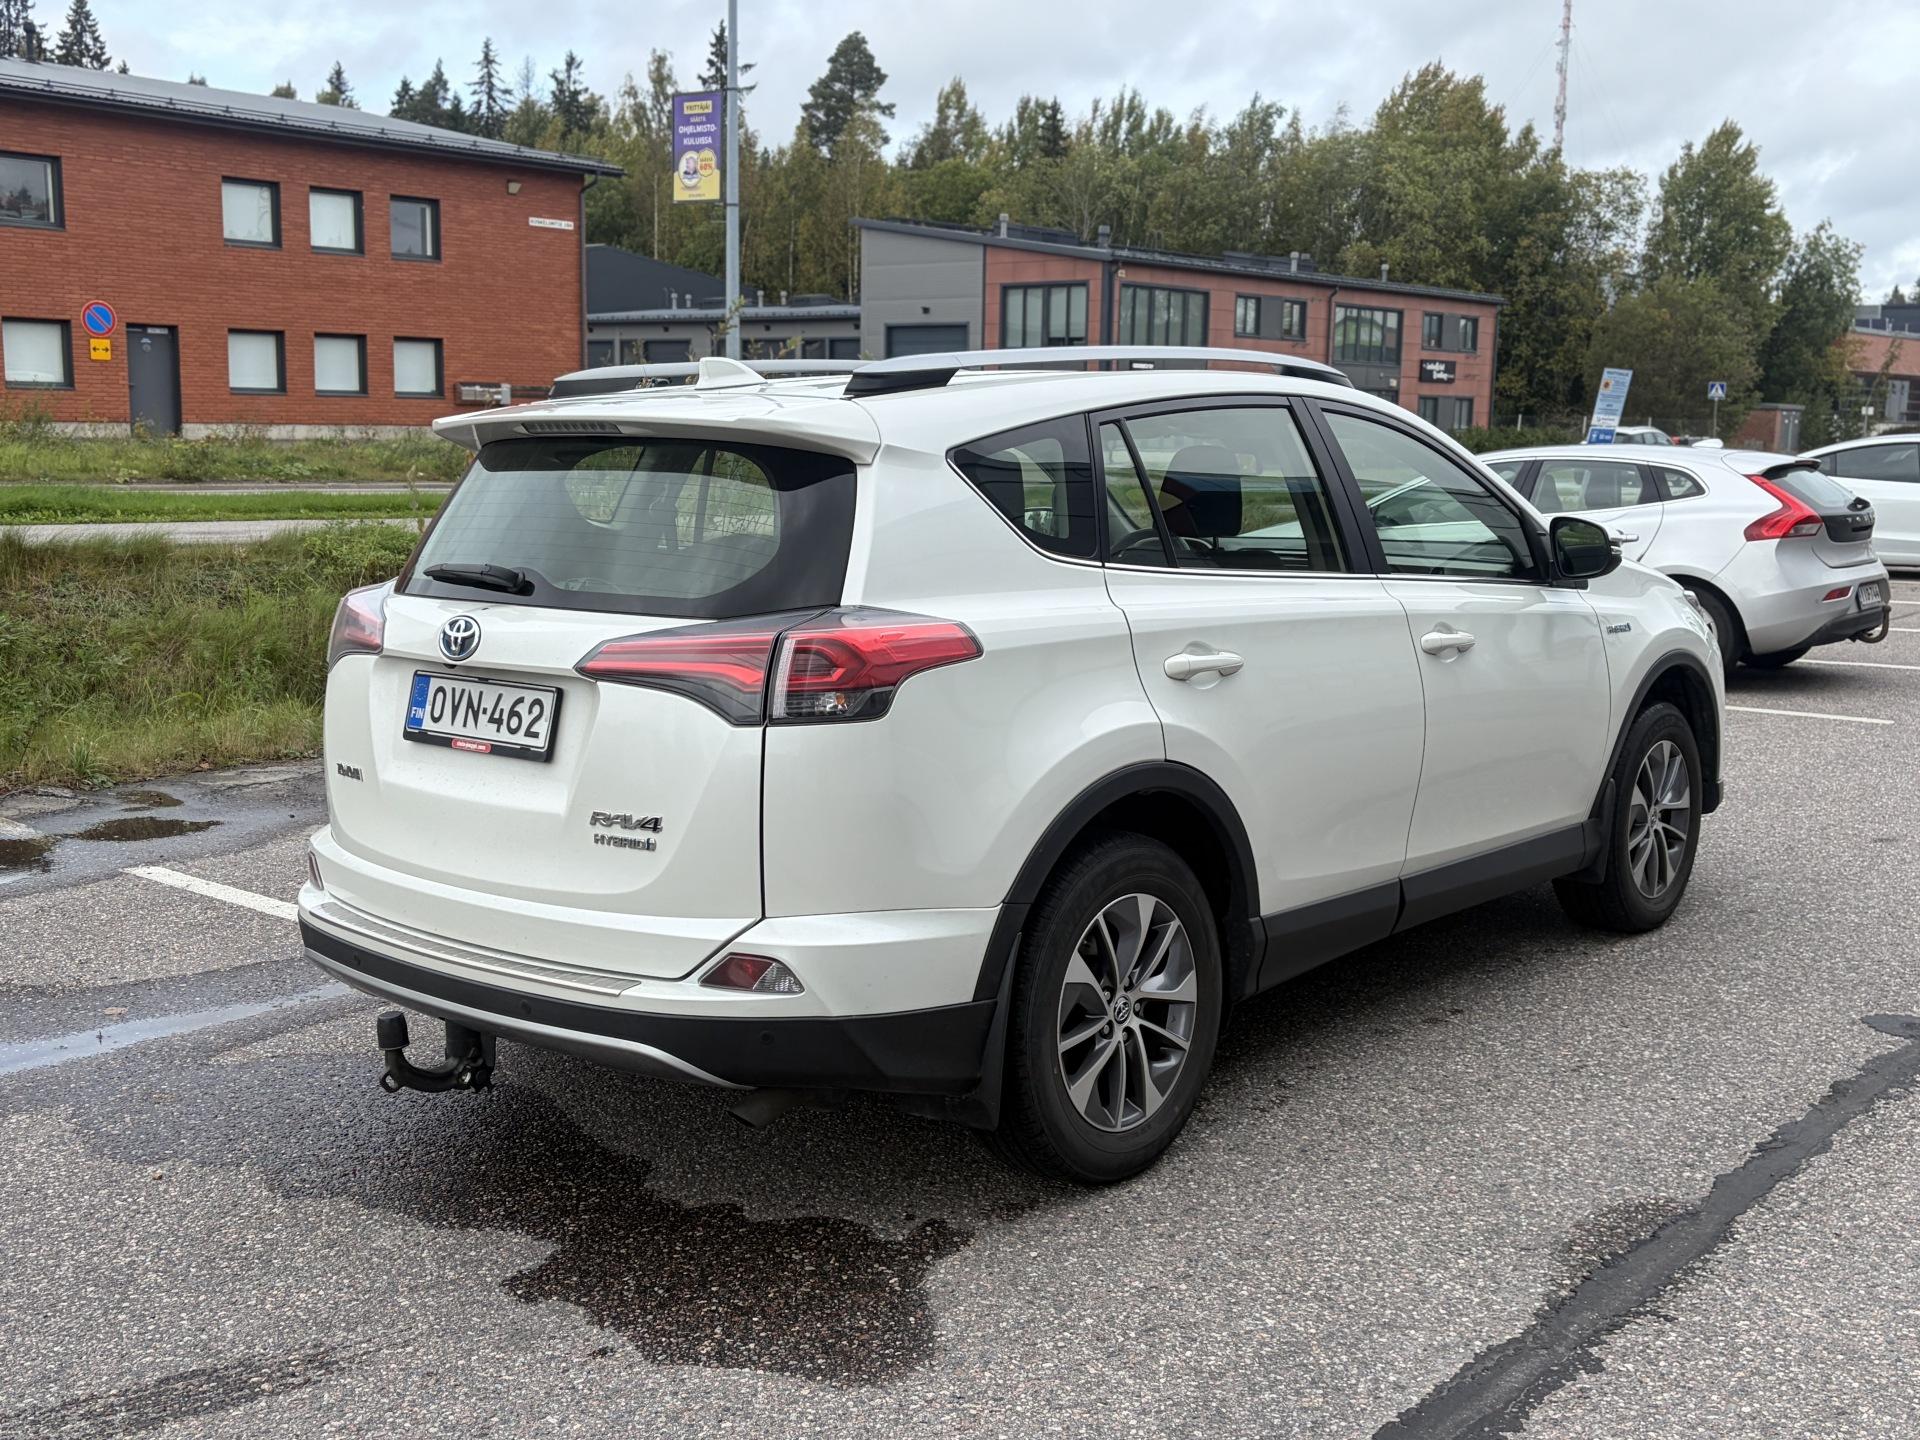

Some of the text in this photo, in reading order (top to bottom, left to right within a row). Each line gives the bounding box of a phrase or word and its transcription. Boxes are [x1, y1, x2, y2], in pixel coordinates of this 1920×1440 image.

[678, 124, 717, 135] OHJELMISTO-
[683, 136, 712, 145] KULUISSA
[410, 706, 424, 720] FIN
[430, 685, 545, 739] OVN-462
[590, 810, 663, 834] RAV4
